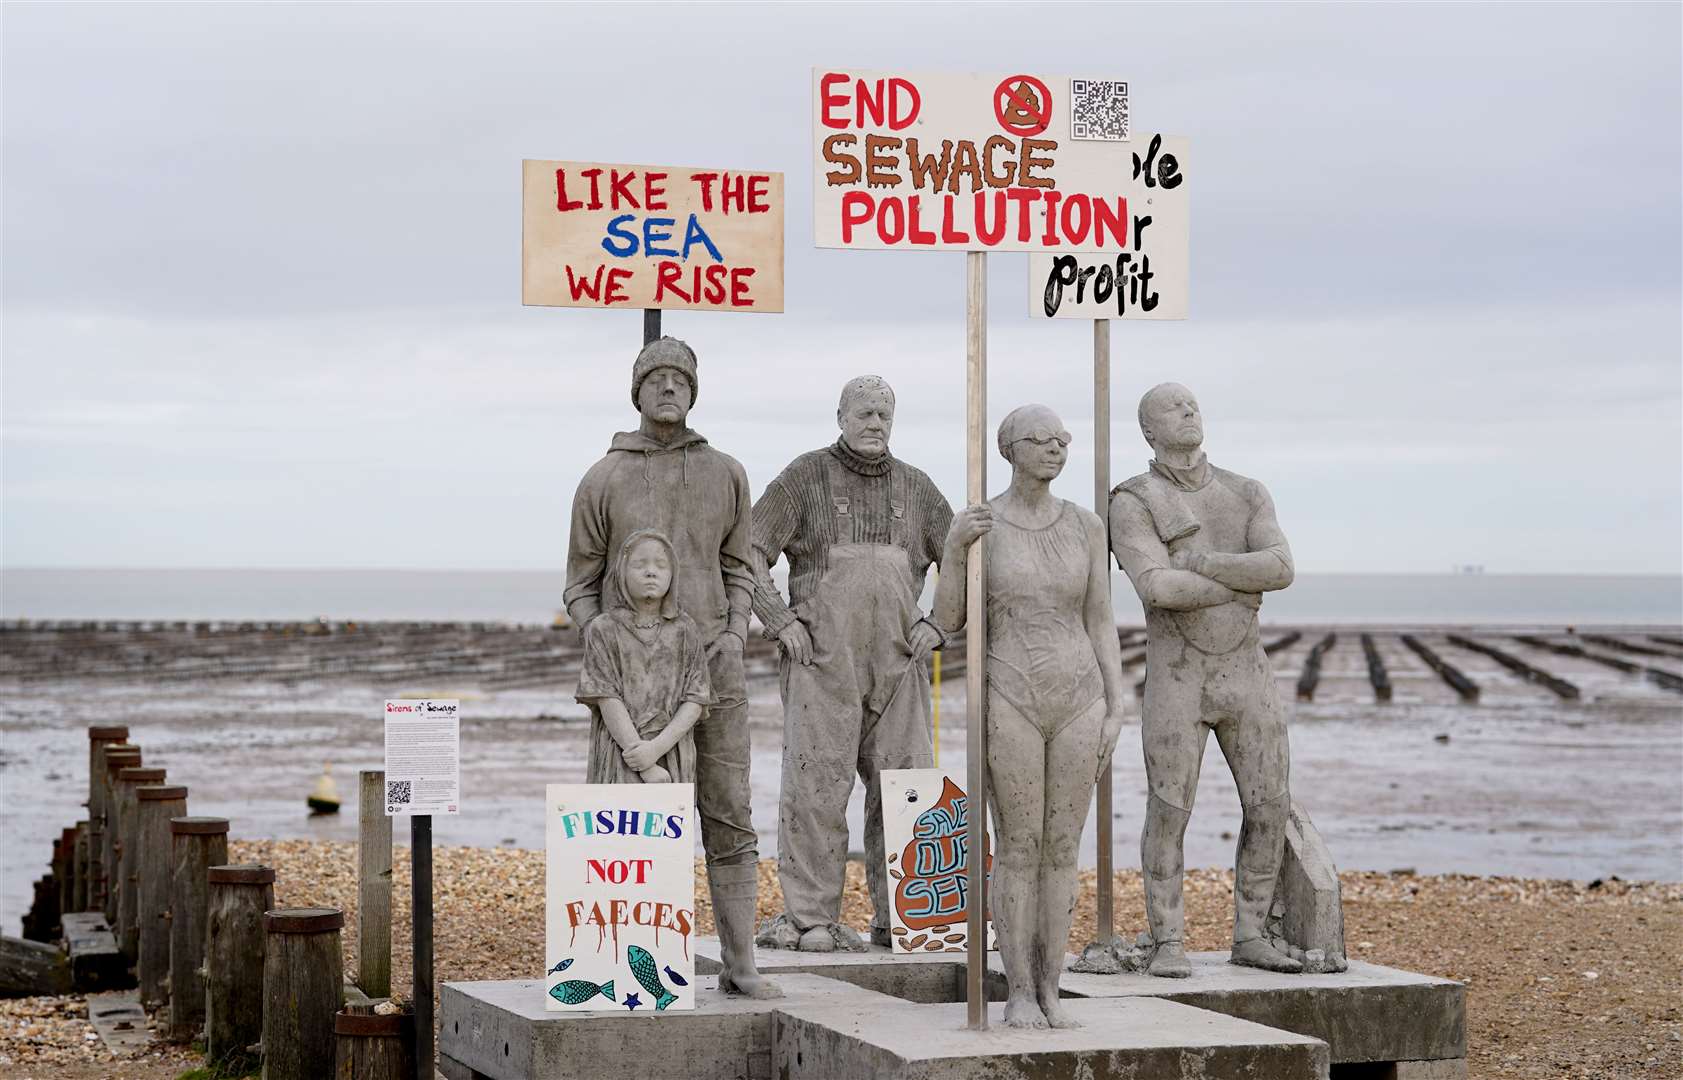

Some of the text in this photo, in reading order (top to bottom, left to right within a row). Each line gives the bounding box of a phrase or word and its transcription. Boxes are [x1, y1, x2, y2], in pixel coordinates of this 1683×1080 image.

[820, 73, 921, 131] END
[822, 133, 1058, 195] SEWAGE
[555, 168, 770, 215] LIKE THE
[601, 213, 723, 263] SEA
[841, 187, 1128, 248] POLLUTION
[565, 261, 756, 307] WE RISE
[1044, 253, 1159, 318] profit
[386, 702, 413, 713] Sirens
[561, 809, 684, 839] FISHES
[584, 858, 653, 884] NOT
[565, 899, 694, 940] FAECES
